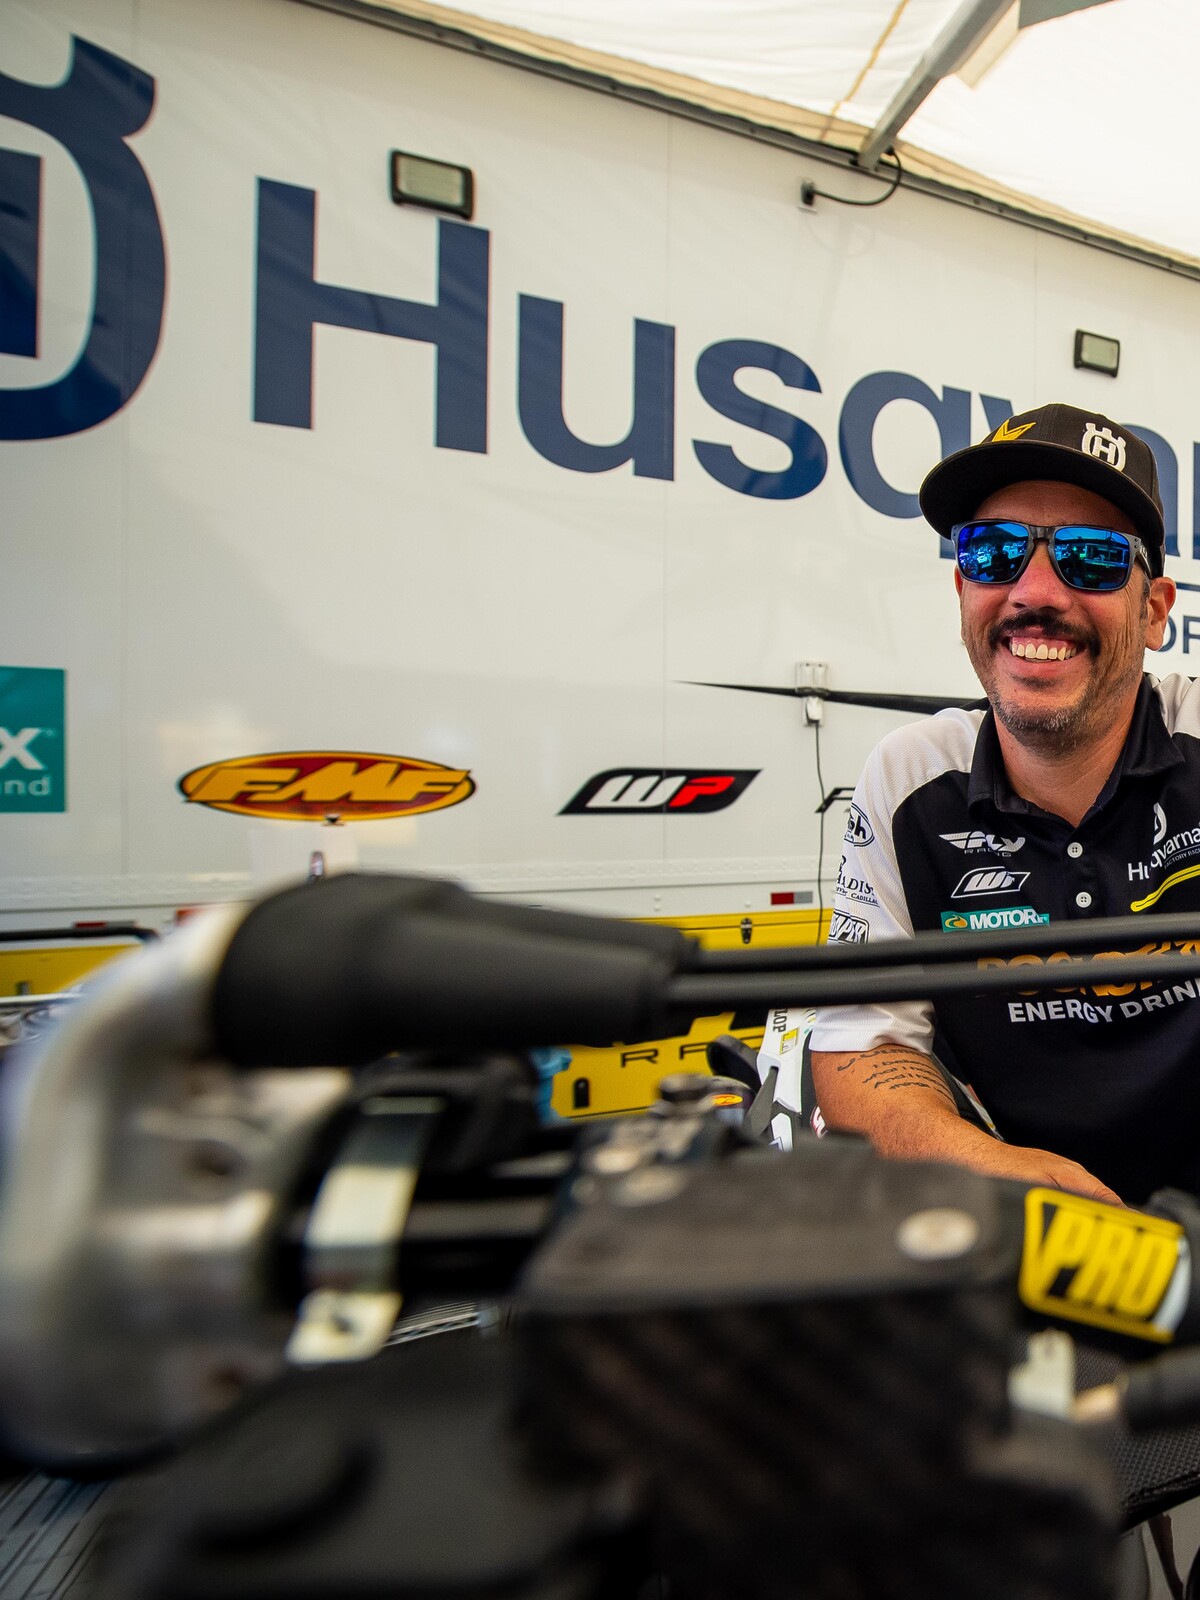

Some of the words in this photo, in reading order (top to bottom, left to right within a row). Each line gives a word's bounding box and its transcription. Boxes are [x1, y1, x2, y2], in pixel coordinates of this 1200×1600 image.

[185, 760, 469, 802] FMF
[585, 775, 735, 808] WP
[1007, 998, 1114, 1024] ENERGY
